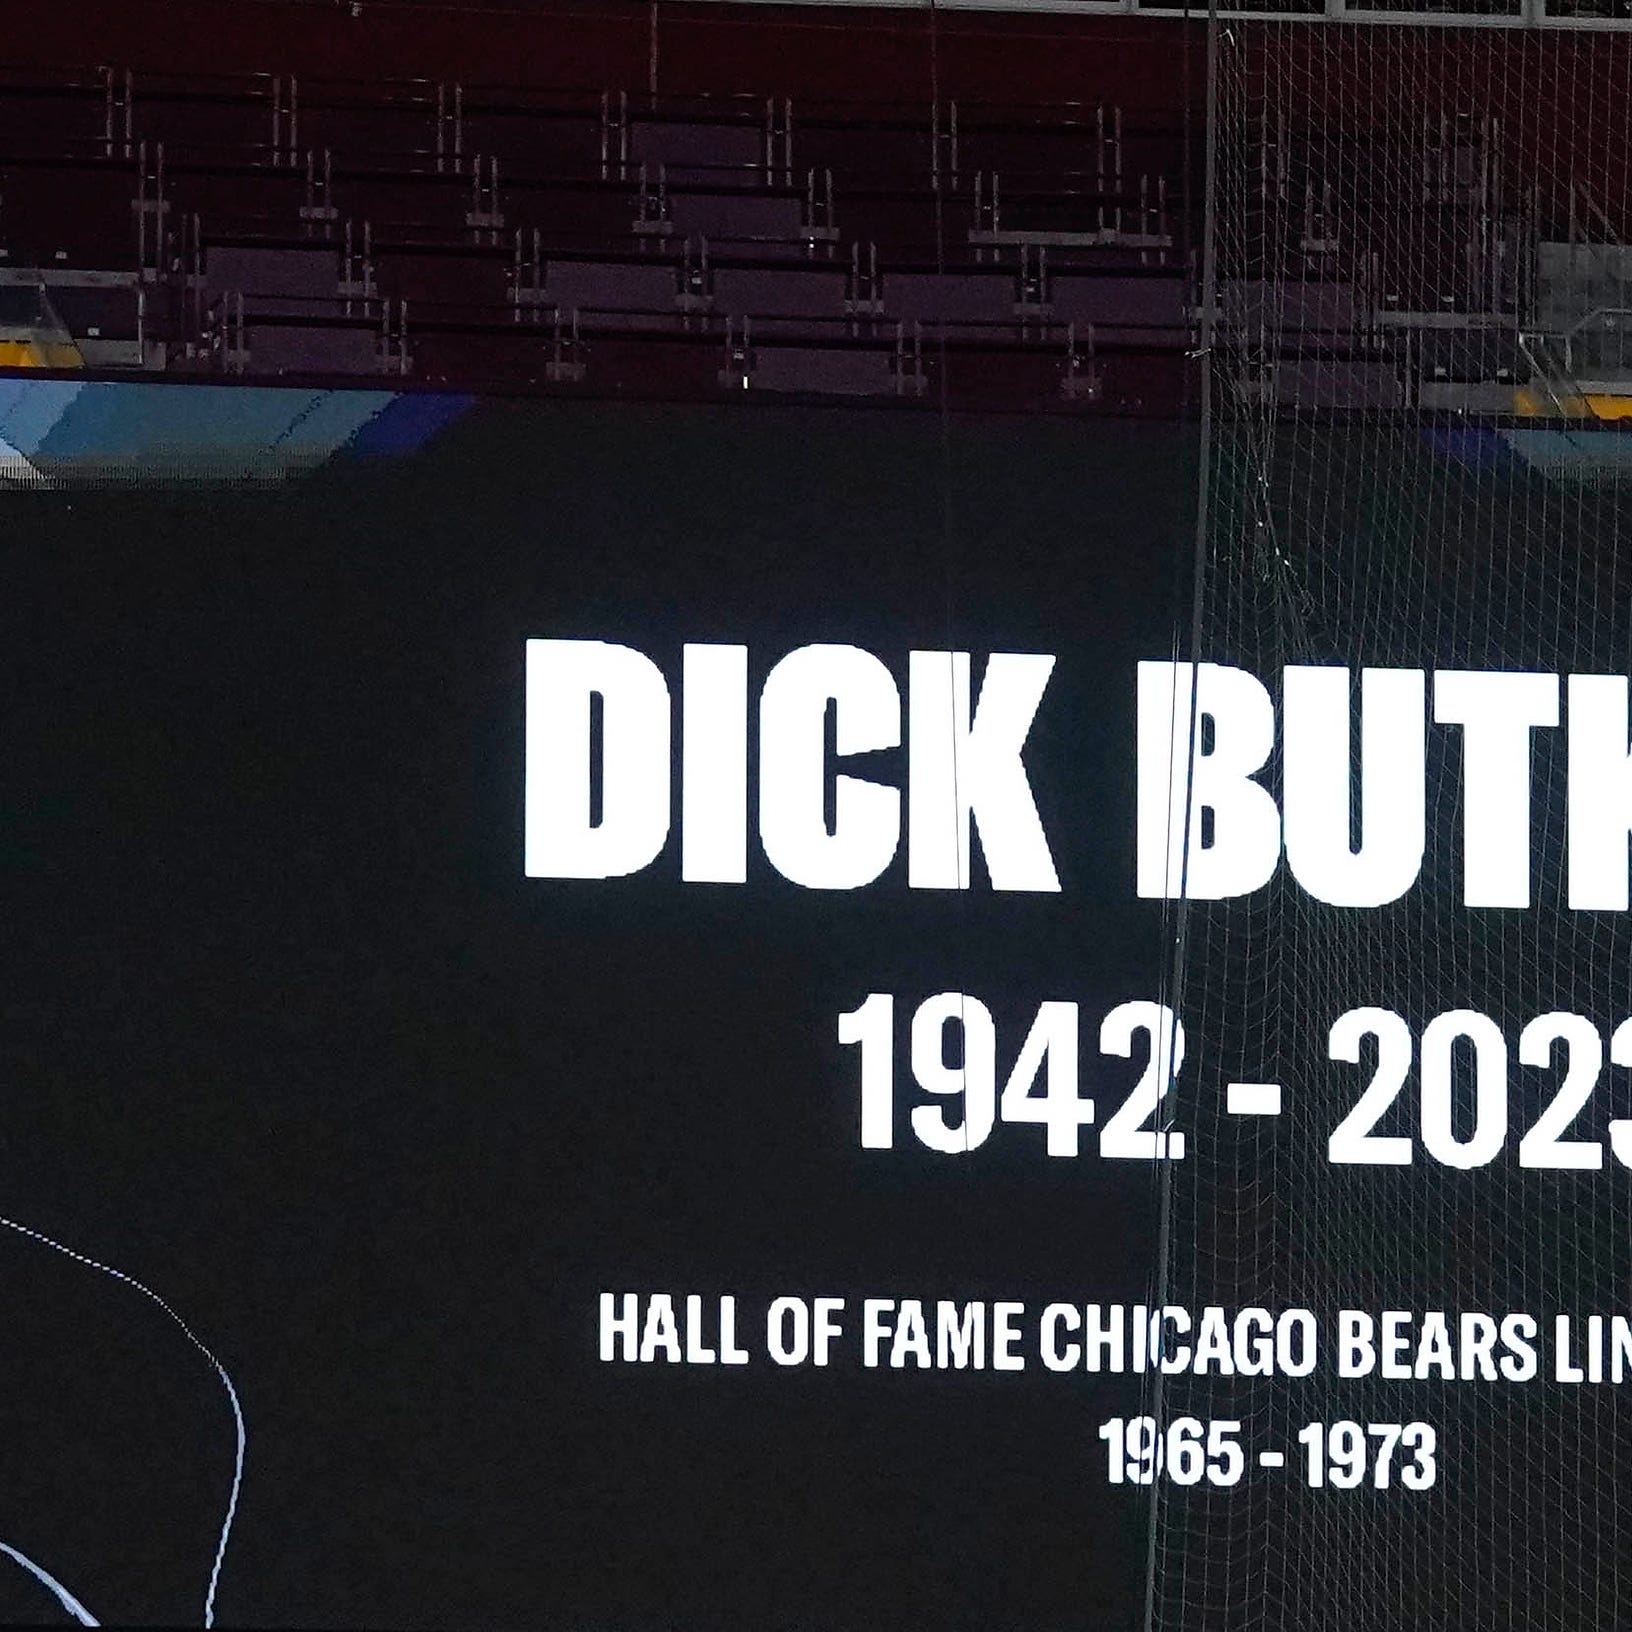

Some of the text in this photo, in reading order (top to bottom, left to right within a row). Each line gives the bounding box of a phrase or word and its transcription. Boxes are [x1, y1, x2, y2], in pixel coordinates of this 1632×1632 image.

[525, 639, 1062, 893] DICK
[838, 993, 1185, 1160] 1942
[599, 1292, 749, 1365] HALL
[767, 1296, 845, 1367] OF
[864, 1299, 1025, 1372] FAME
[1040, 1303, 1318, 1378] CHICAGO
[1338, 1309, 1537, 1383] BEARS
[1099, 1416, 1244, 1486] 1965
[1298, 1420, 1436, 1490] 1973
